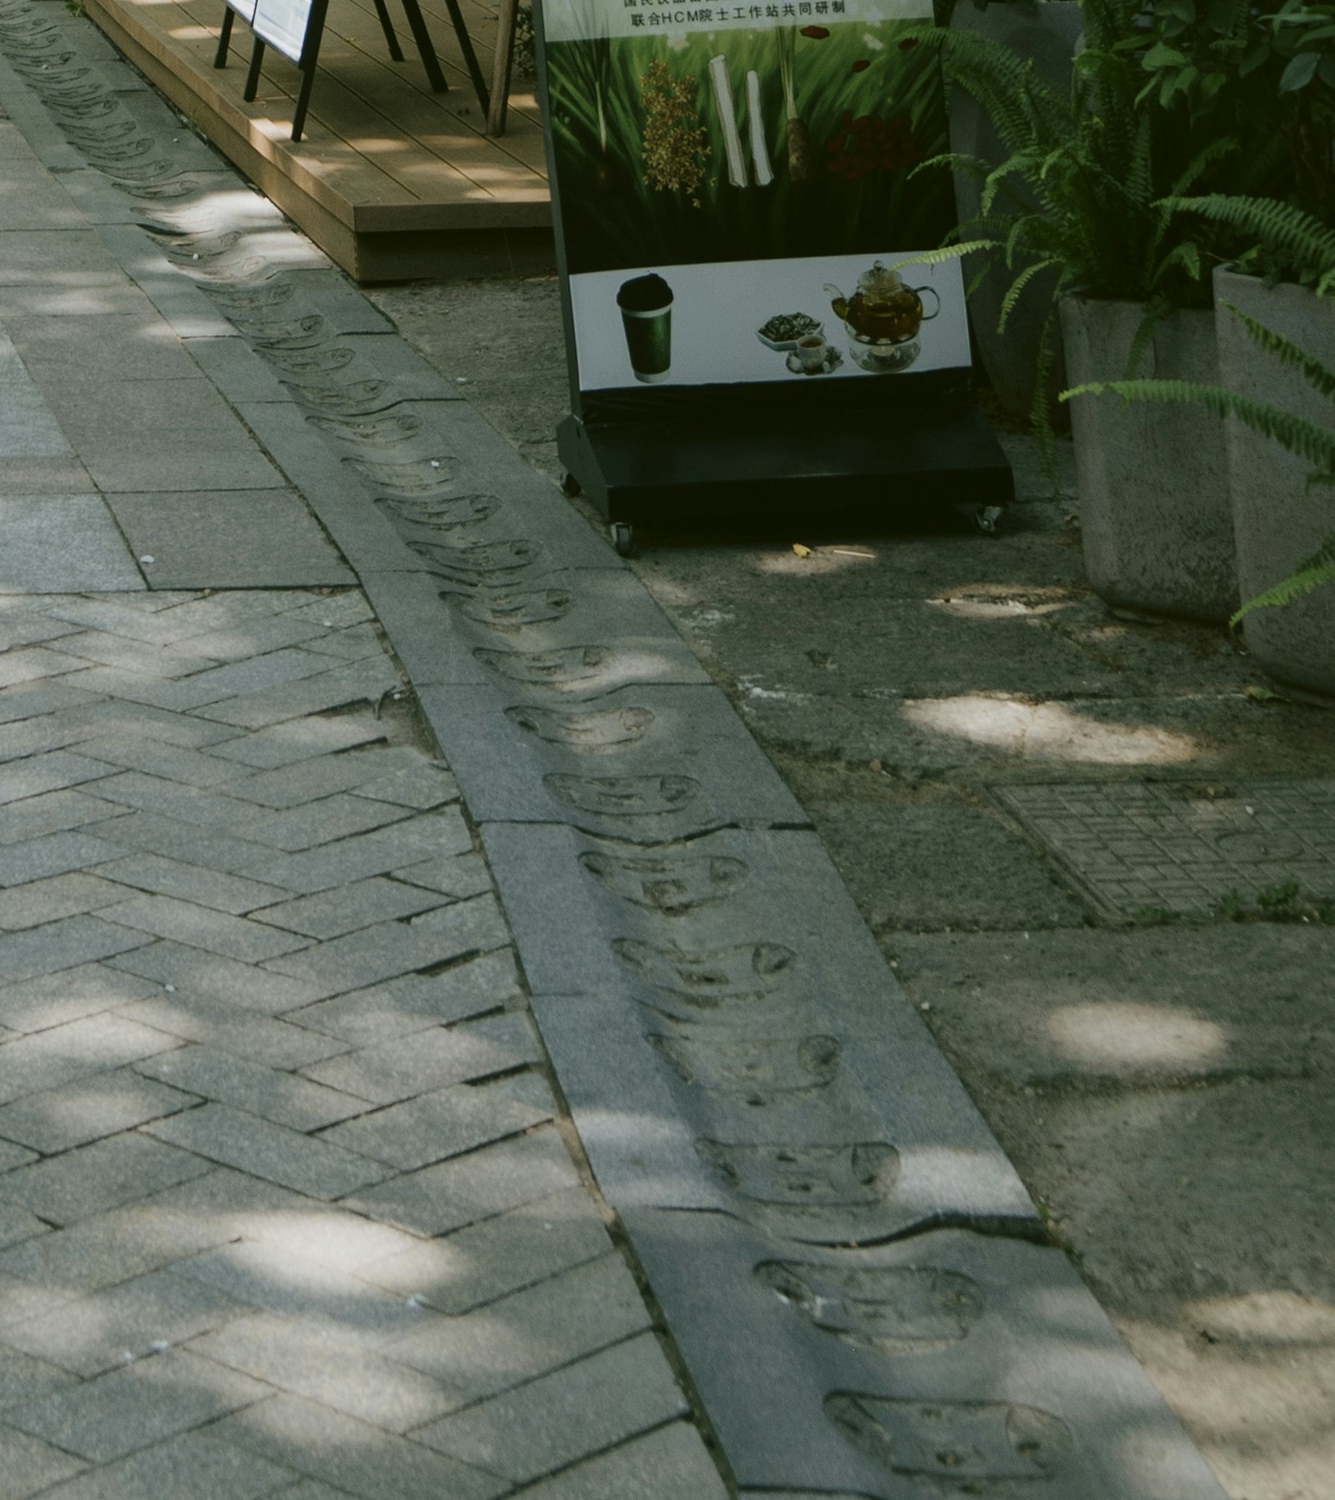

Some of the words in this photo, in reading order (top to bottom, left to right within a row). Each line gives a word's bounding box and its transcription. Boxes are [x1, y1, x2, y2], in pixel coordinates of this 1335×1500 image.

[631, 0, 847, 28] 联合HCM院士工作站共同研制
